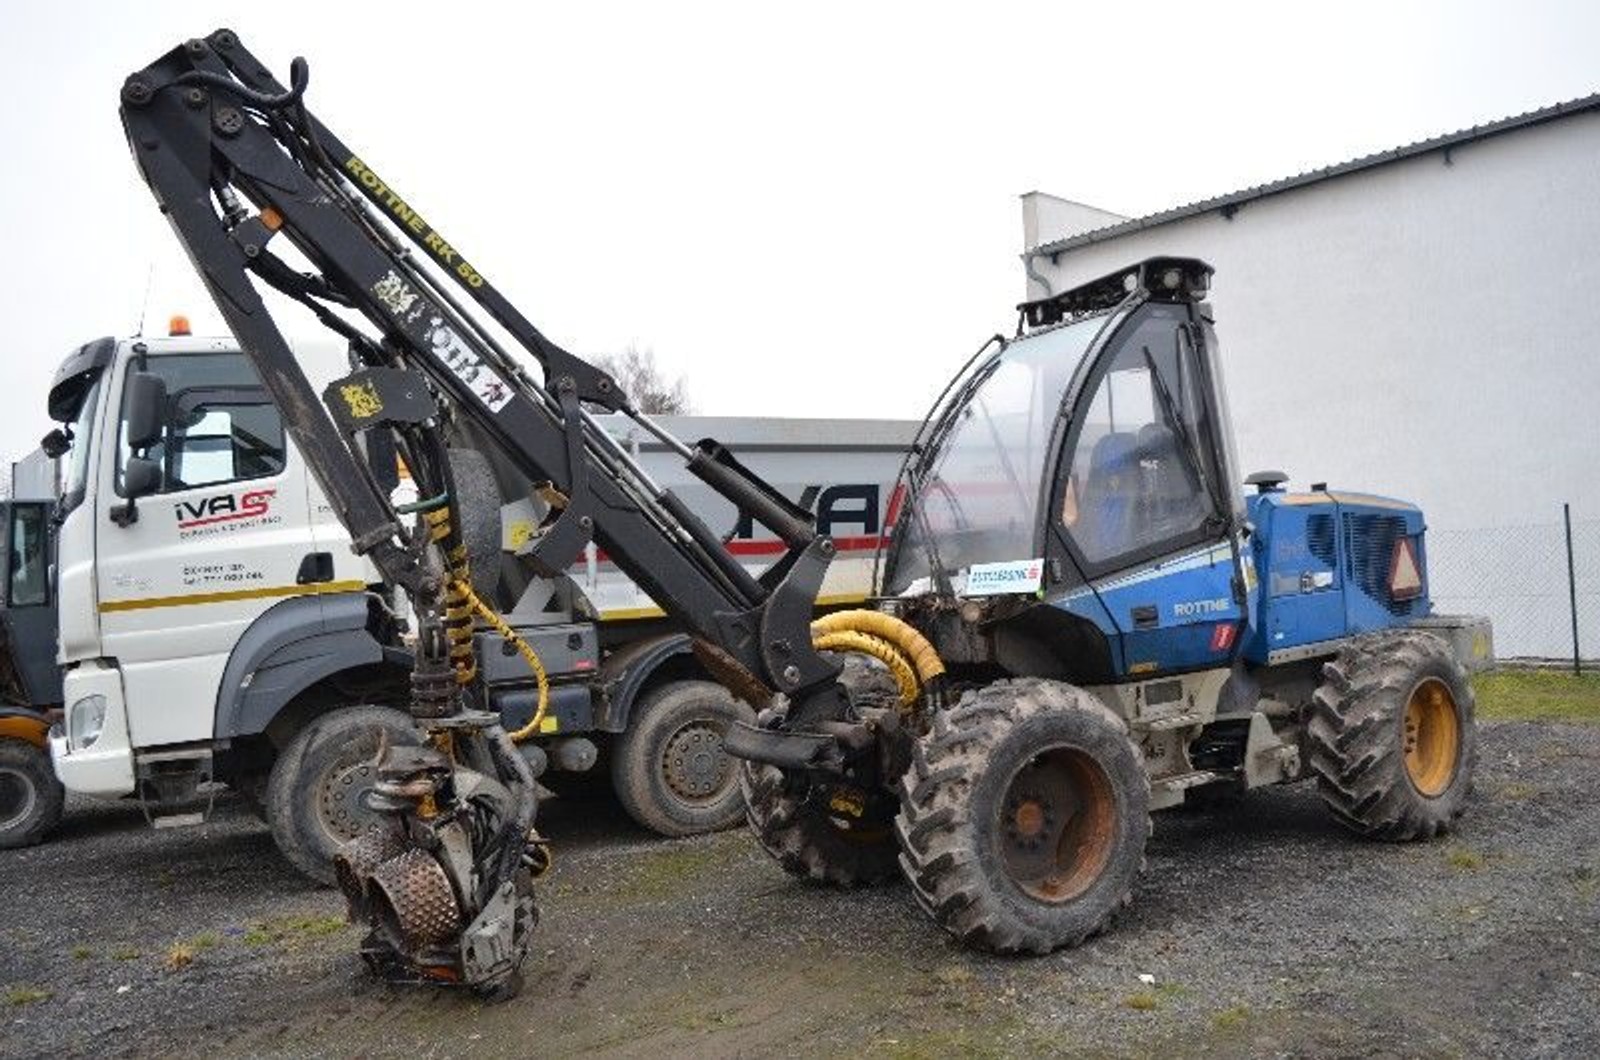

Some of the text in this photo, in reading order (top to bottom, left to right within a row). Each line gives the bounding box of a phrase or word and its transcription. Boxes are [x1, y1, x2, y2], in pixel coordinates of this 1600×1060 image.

[346, 156, 483, 288] ROTTNE RK 50
[1173, 598, 1230, 617] ROTTNE
